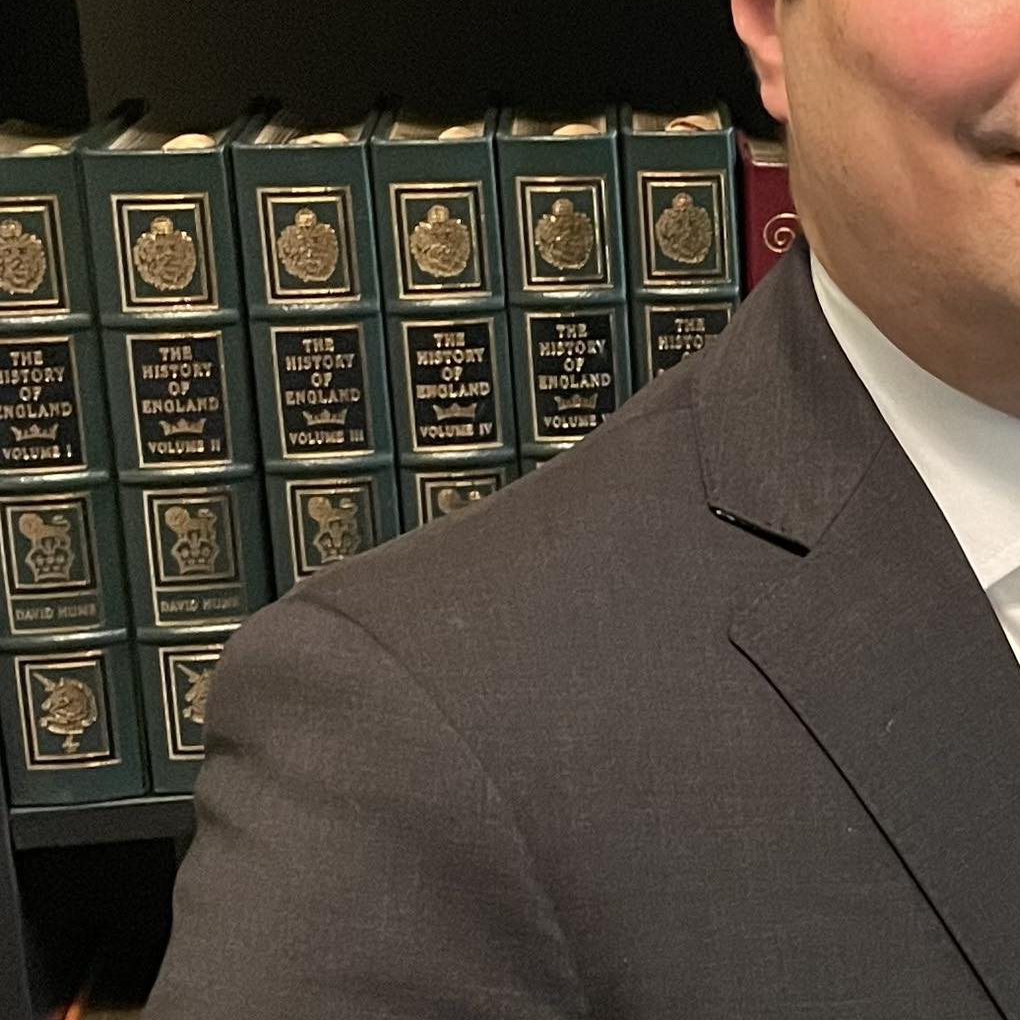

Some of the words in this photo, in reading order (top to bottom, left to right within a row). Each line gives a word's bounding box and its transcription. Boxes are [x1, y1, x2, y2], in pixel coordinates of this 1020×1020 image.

[556, 323, 587, 339] THE
[675, 318, 705, 333] THE
[303, 337, 334, 353] THE
[433, 332, 465, 347] THE
[159, 345, 192, 361] THE
[538, 339, 606, 357] HISTORY
[10, 350, 43, 367] THE
[285, 353, 355, 371] HISTORY
[416, 348, 485, 365] HISTORY
[563, 357, 585, 372] OF
[141, 362, 212, 379] HISTORY
[441, 366, 463, 381] OF
[311, 372, 333, 387] OF
[538, 372, 611, 390] ENGLAND
[19, 386, 42, 401] OF
[168, 381, 191, 396] OF
[285, 387, 360, 406] ENGLAND
[416, 382, 491, 399] ENGLAND
[141, 396, 219, 414] ENGLAND
[543, 414, 597, 429] VOLUME
[289, 430, 345, 445] VOLUME
[351, 429, 364, 443] III
[419, 423, 474, 438] VOLUME
[479, 422, 493, 436] IV
[2, 445, 61, 461] VOLUME
[148, 440, 204, 454] VOLUME
[211, 438, 221, 452] II
[15, 608, 53, 621] DAVID
[57, 603, 97, 619] HUME
[161, 598, 197, 613] DAVID
[202, 596, 240, 611] HUME
